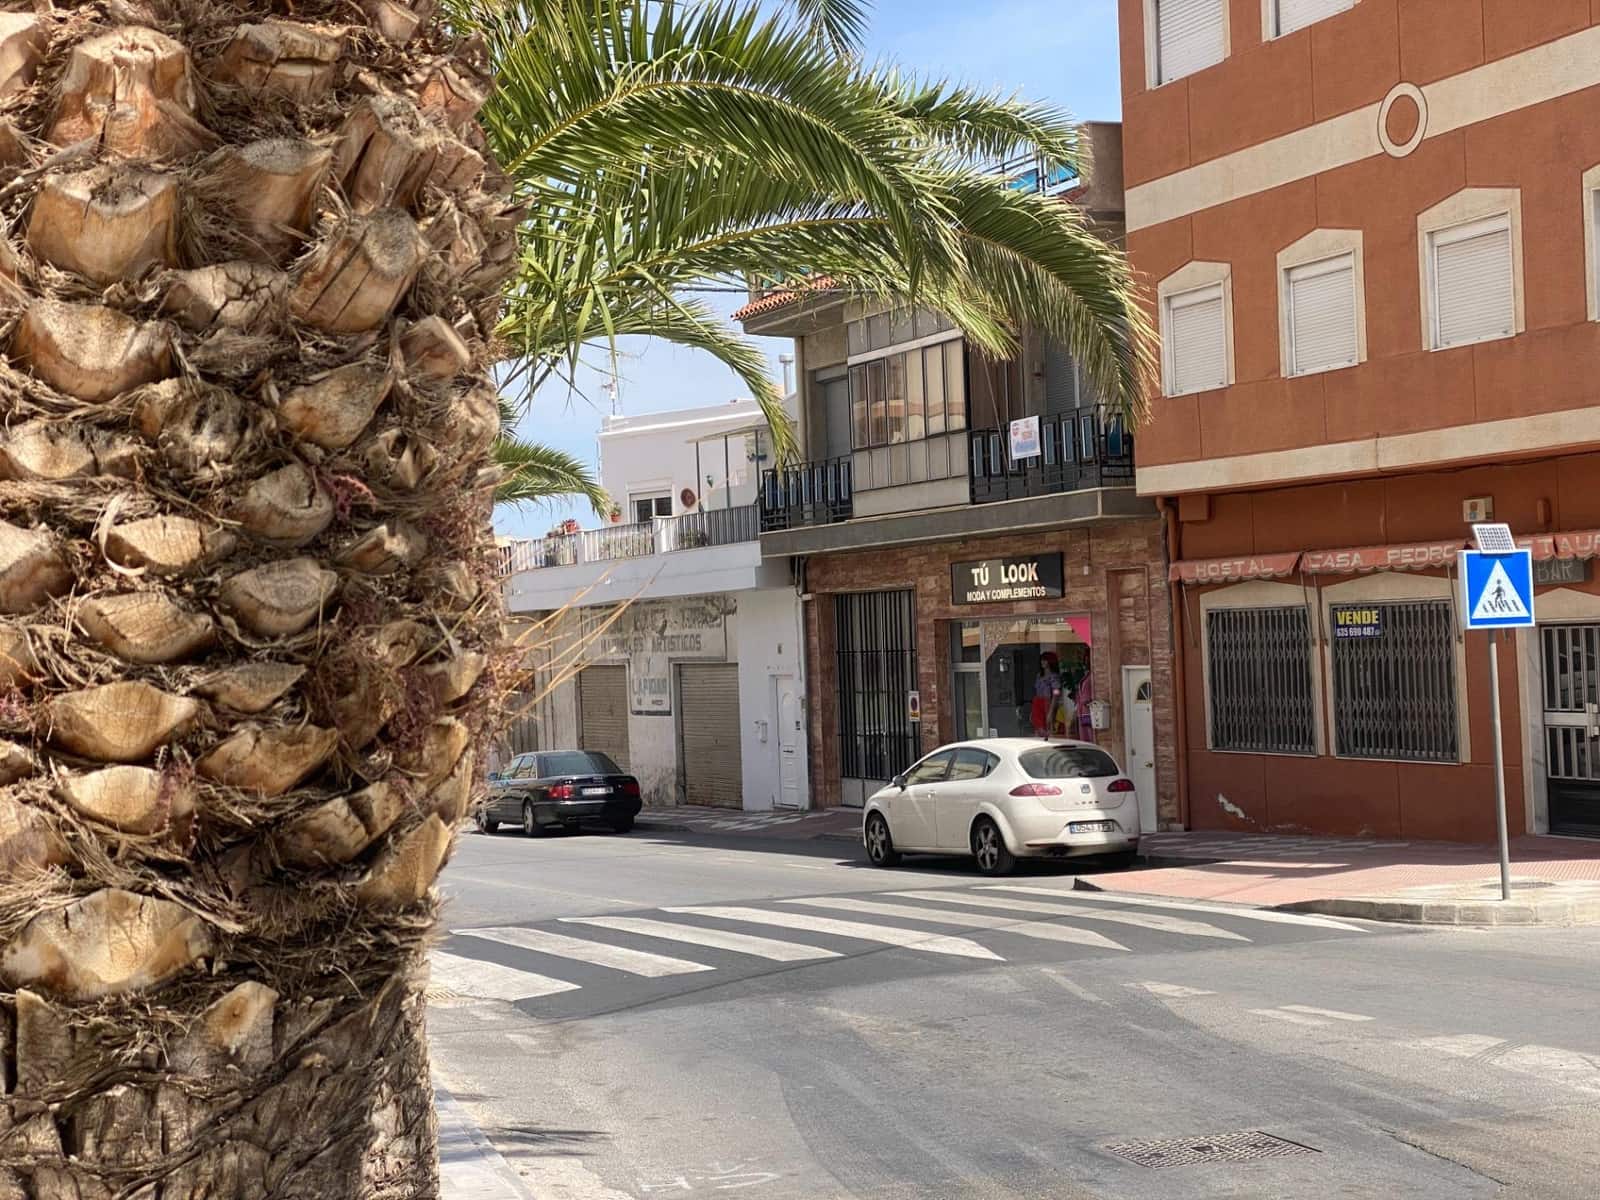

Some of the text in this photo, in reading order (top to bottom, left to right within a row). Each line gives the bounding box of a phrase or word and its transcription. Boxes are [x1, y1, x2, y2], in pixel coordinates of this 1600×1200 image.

[971, 562, 1038, 586] TÚ LOOK
[1195, 559, 1274, 577] HOSTAL
[1310, 552, 1364, 569] CASA
[1536, 559, 1574, 581] BAR
[966, 590, 986, 602] MODA
[991, 586, 1046, 600] COMPLEMENTOS
[1336, 610, 1379, 625] VENDE
